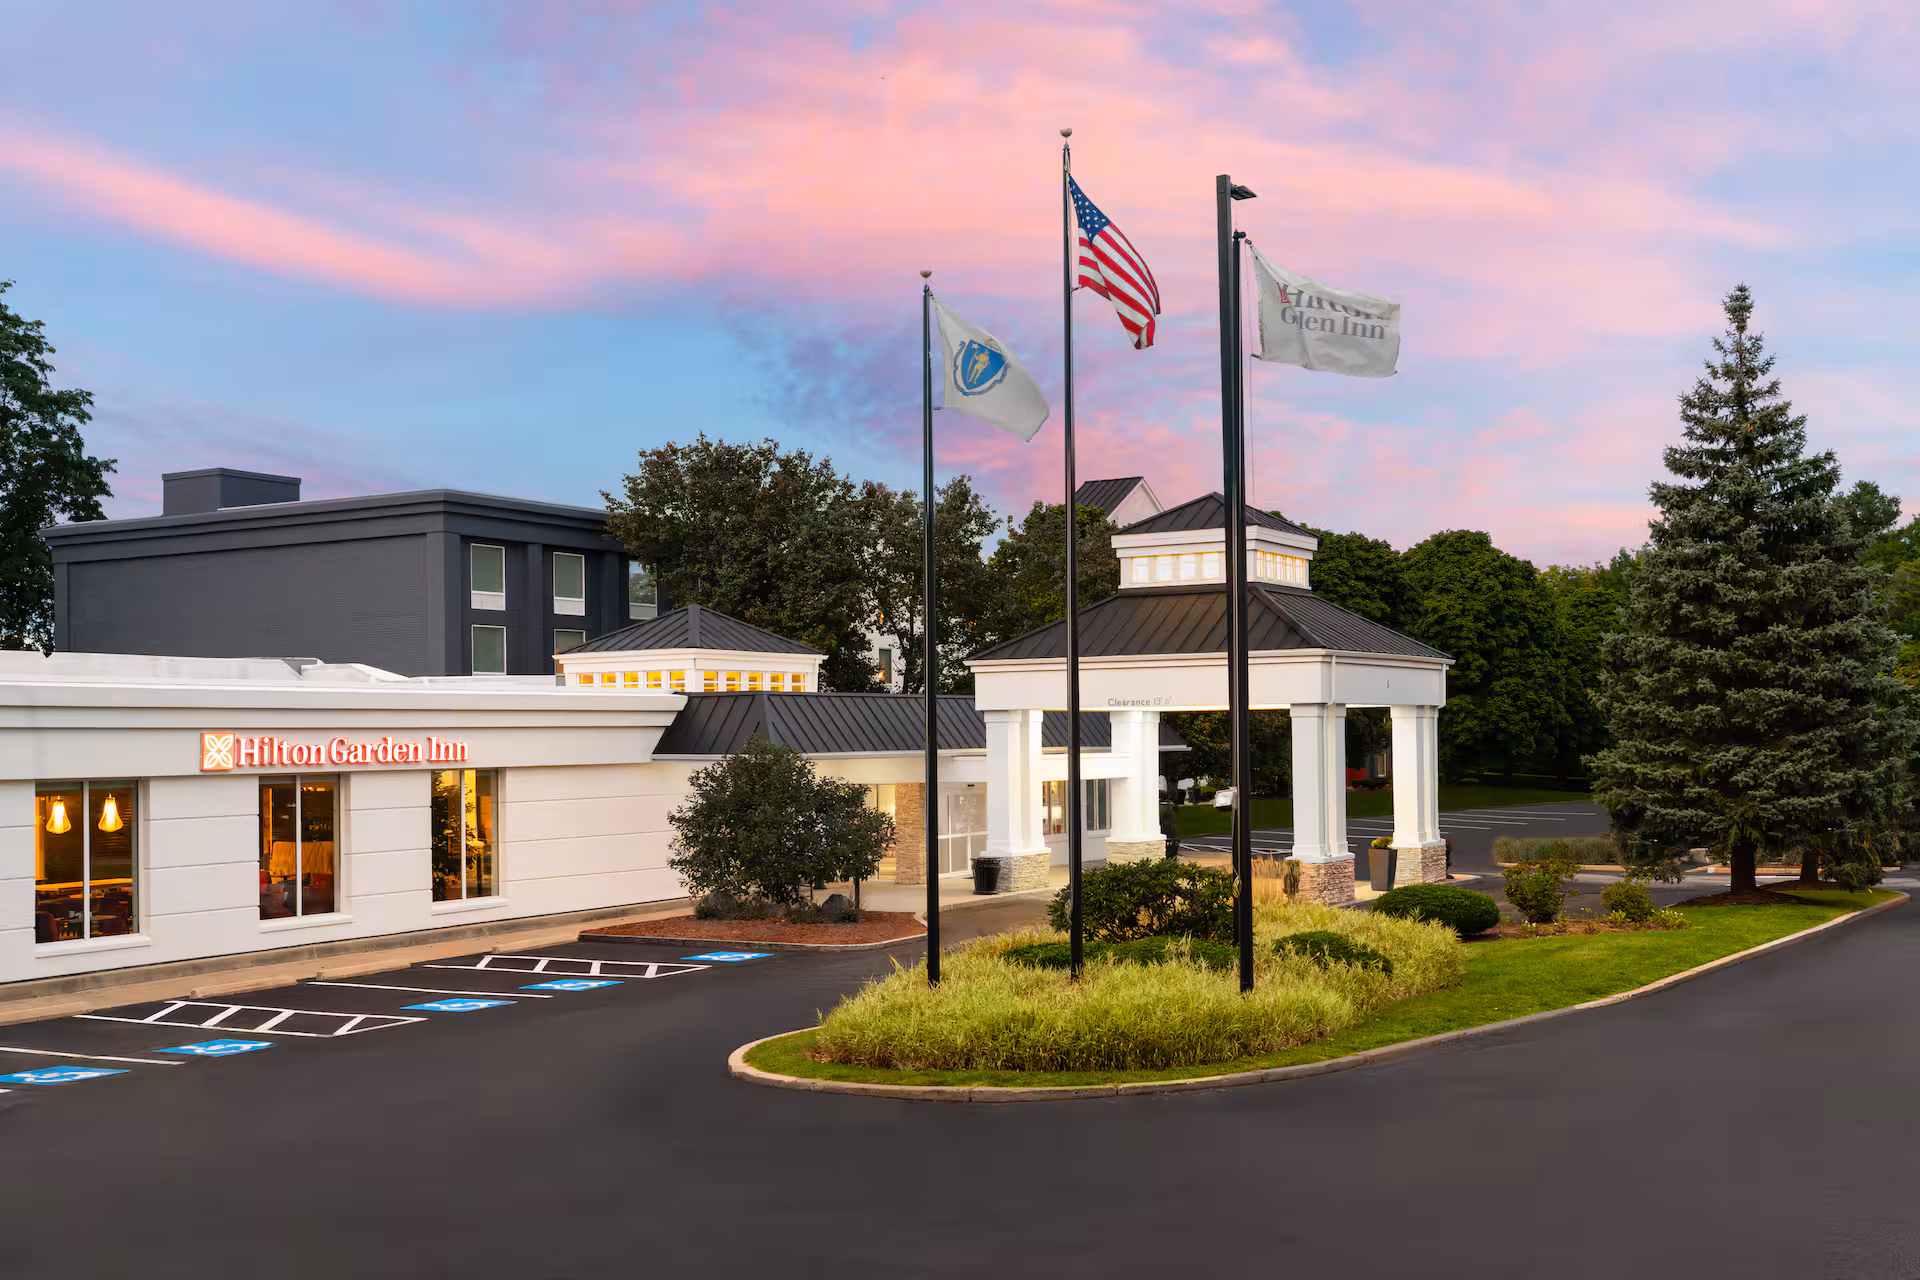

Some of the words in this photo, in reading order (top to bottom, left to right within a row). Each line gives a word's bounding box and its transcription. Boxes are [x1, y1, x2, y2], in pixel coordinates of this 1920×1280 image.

[1341, 316, 1385, 339] Inn
[1108, 698, 1151, 706] Clearance
[237, 737, 327, 766] Hilton
[330, 736, 424, 764] Garden
[428, 736, 469, 761] Inn
